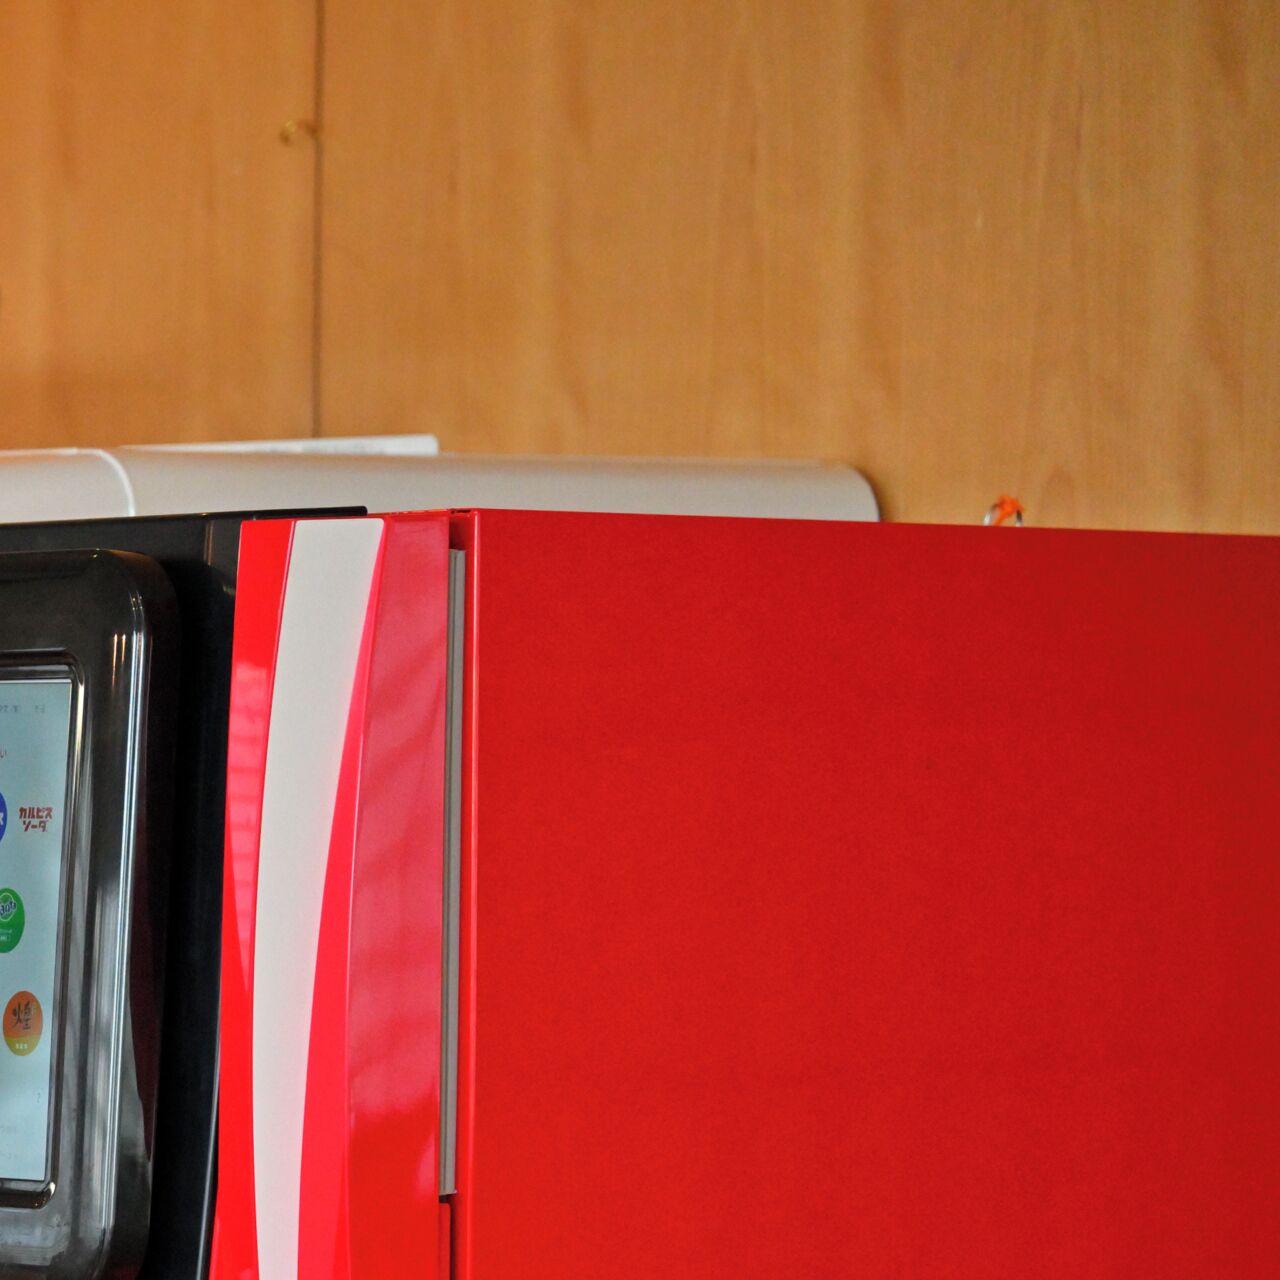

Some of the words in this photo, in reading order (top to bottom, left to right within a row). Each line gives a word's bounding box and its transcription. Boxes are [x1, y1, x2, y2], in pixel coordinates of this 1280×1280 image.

[19, 806, 53, 819] カルピス
[22, 820, 48, 832] ソーダ
